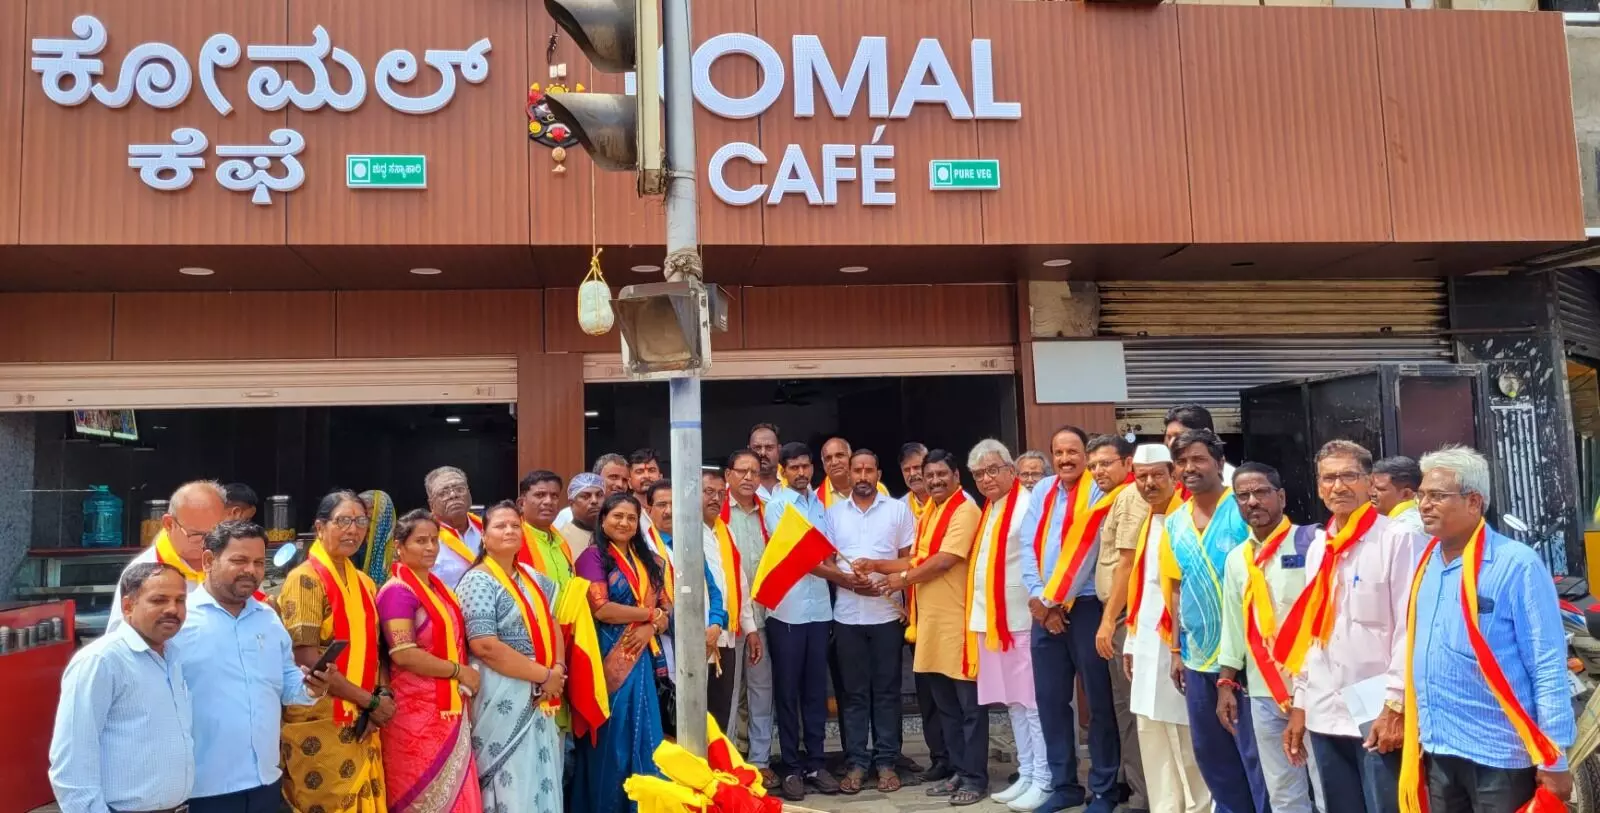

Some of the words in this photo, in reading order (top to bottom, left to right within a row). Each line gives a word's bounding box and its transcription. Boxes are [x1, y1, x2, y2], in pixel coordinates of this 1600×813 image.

[30, 14, 493, 116] ಕೋಮಲ್
[625, 33, 1022, 120] OMAL
[128, 127, 306, 205] ಕೆಫೆ
[708, 125, 897, 206] CAFÉ
[953, 168, 975, 179] PURE
[976, 168, 993, 179] VEG
